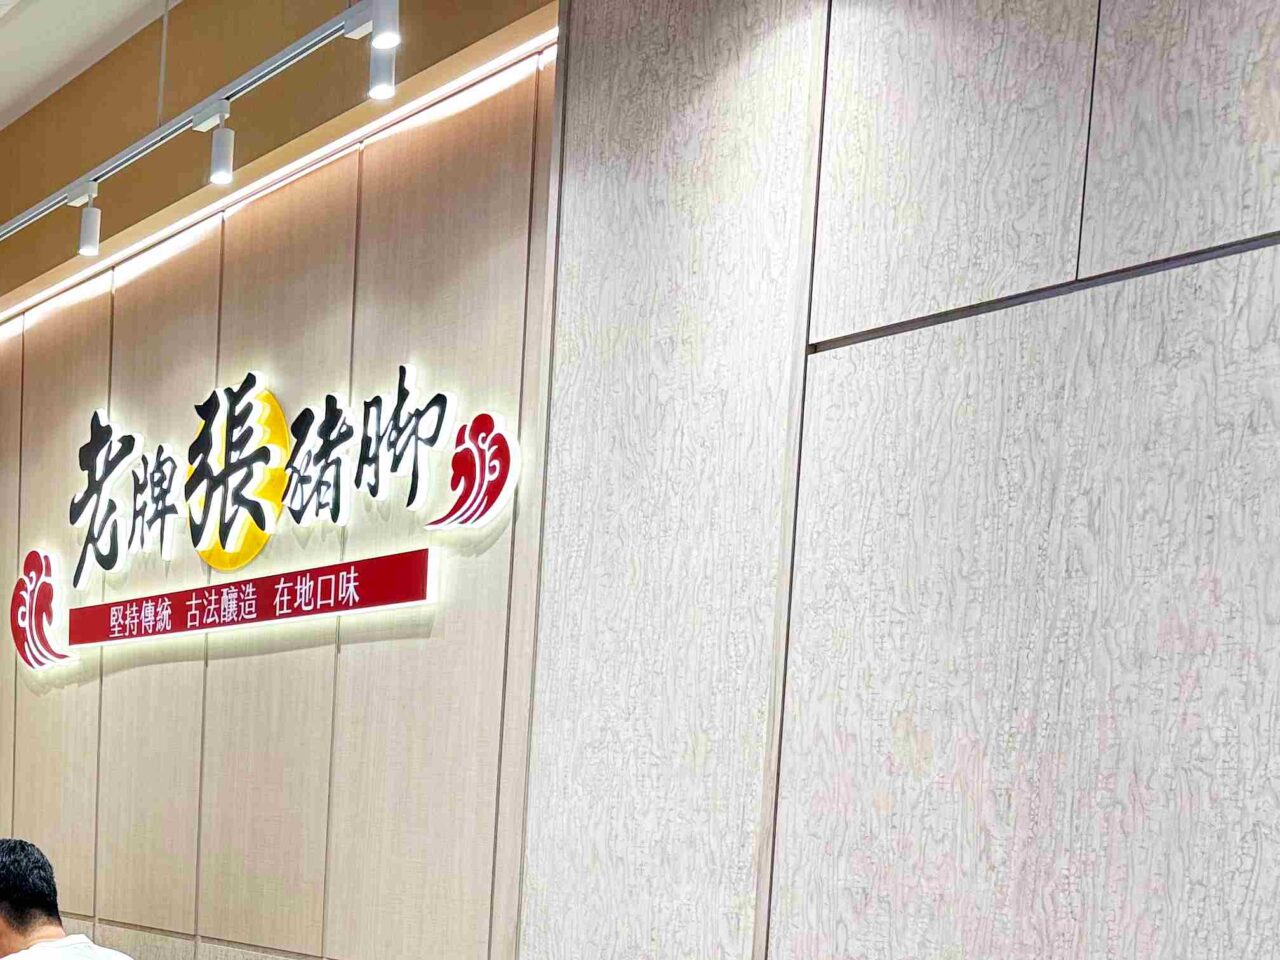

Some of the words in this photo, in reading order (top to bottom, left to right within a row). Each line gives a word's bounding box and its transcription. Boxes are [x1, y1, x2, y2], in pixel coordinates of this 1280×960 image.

[109, 597, 173, 639] 堅持傳統
[185, 582, 257, 628] 古法釀造
[273, 566, 360, 616] 在地口味
